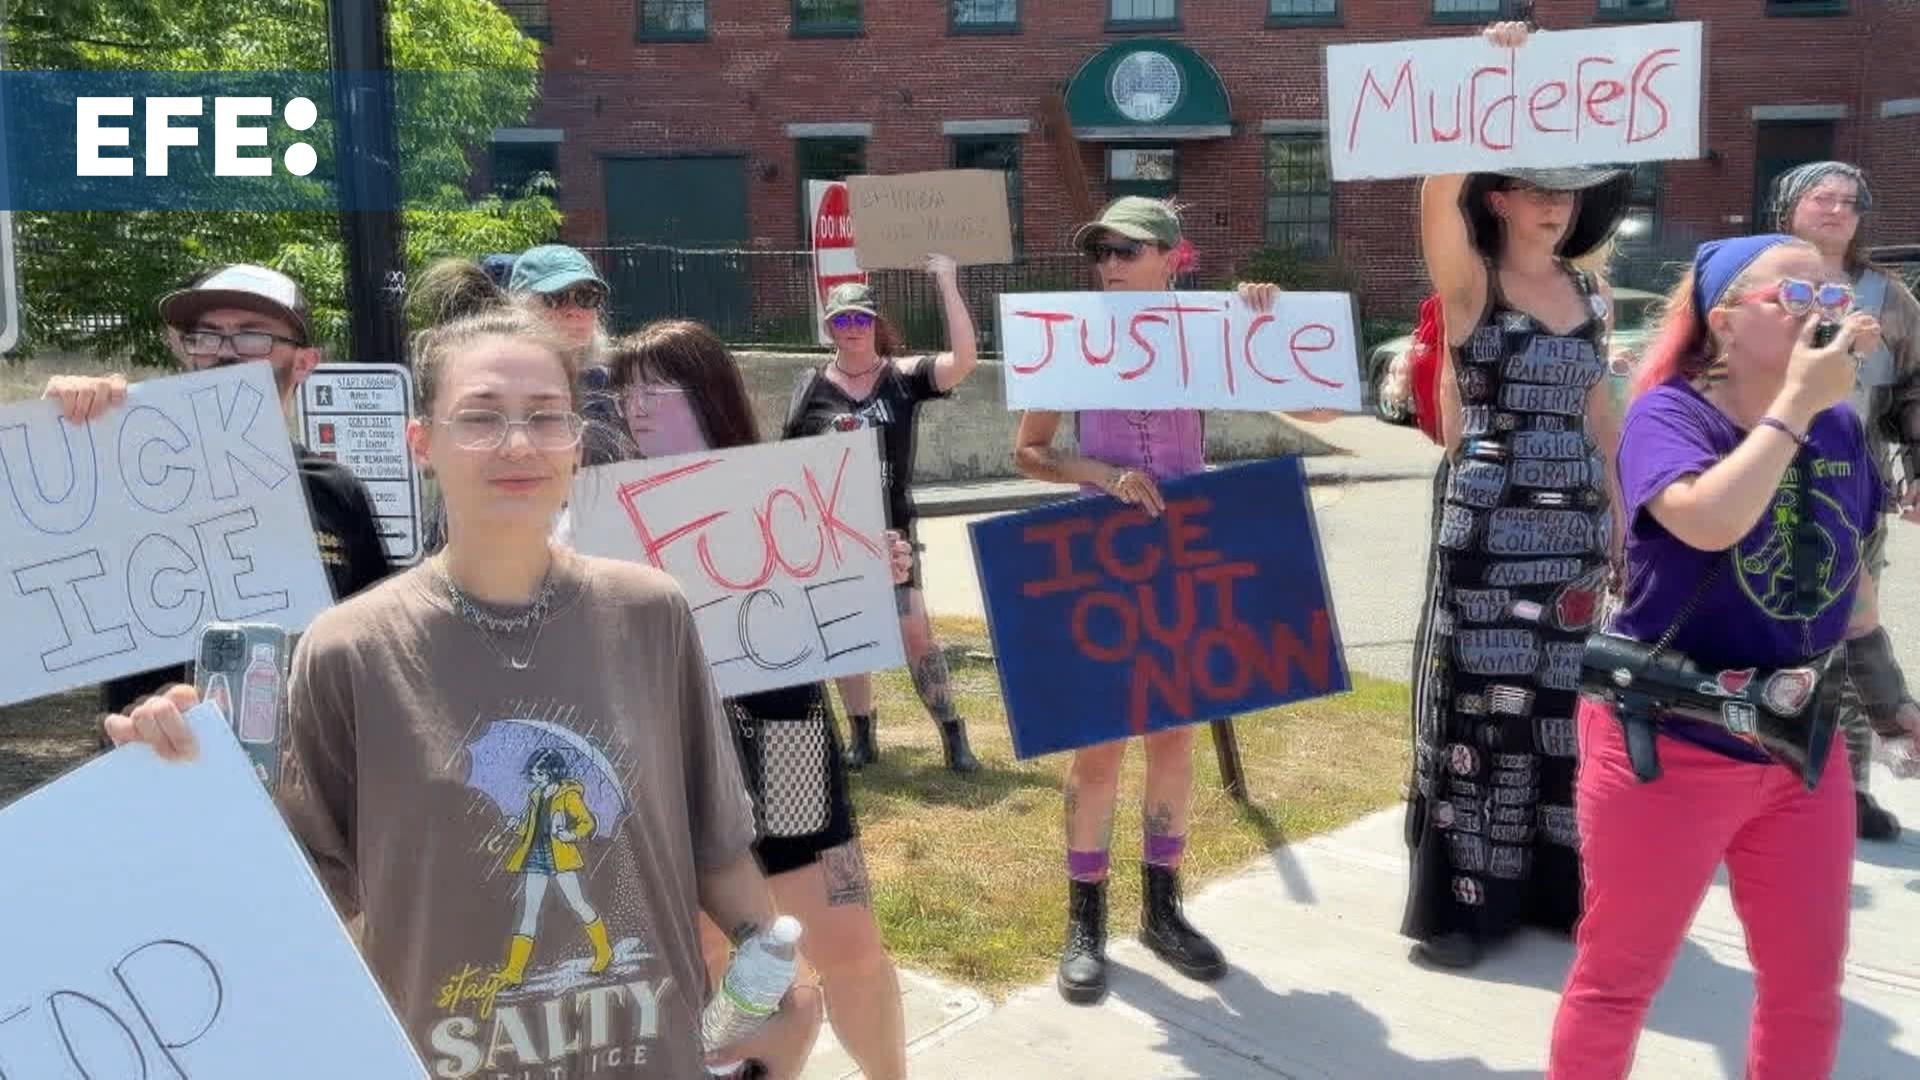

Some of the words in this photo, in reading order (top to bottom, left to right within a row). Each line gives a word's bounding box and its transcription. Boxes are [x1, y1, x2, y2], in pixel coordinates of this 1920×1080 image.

[821, 215, 834, 239] DO
[839, 215, 853, 239] NO
[1535, 339, 1587, 362] FREE
[0, 379, 291, 535] UCK
[1021, 496, 1225, 597] ICE
[13, 507, 289, 672] ICE
[1072, 562, 1259, 662] OUT
[1130, 608, 1331, 734] NOW
[1462, 630, 1533, 649] BELIEVE
[1466, 655, 1538, 673] WOMEN
[432, 976, 675, 1078] SALTY
[437, 963, 509, 1020] stay
[592, 1045, 648, 1073] ICE
